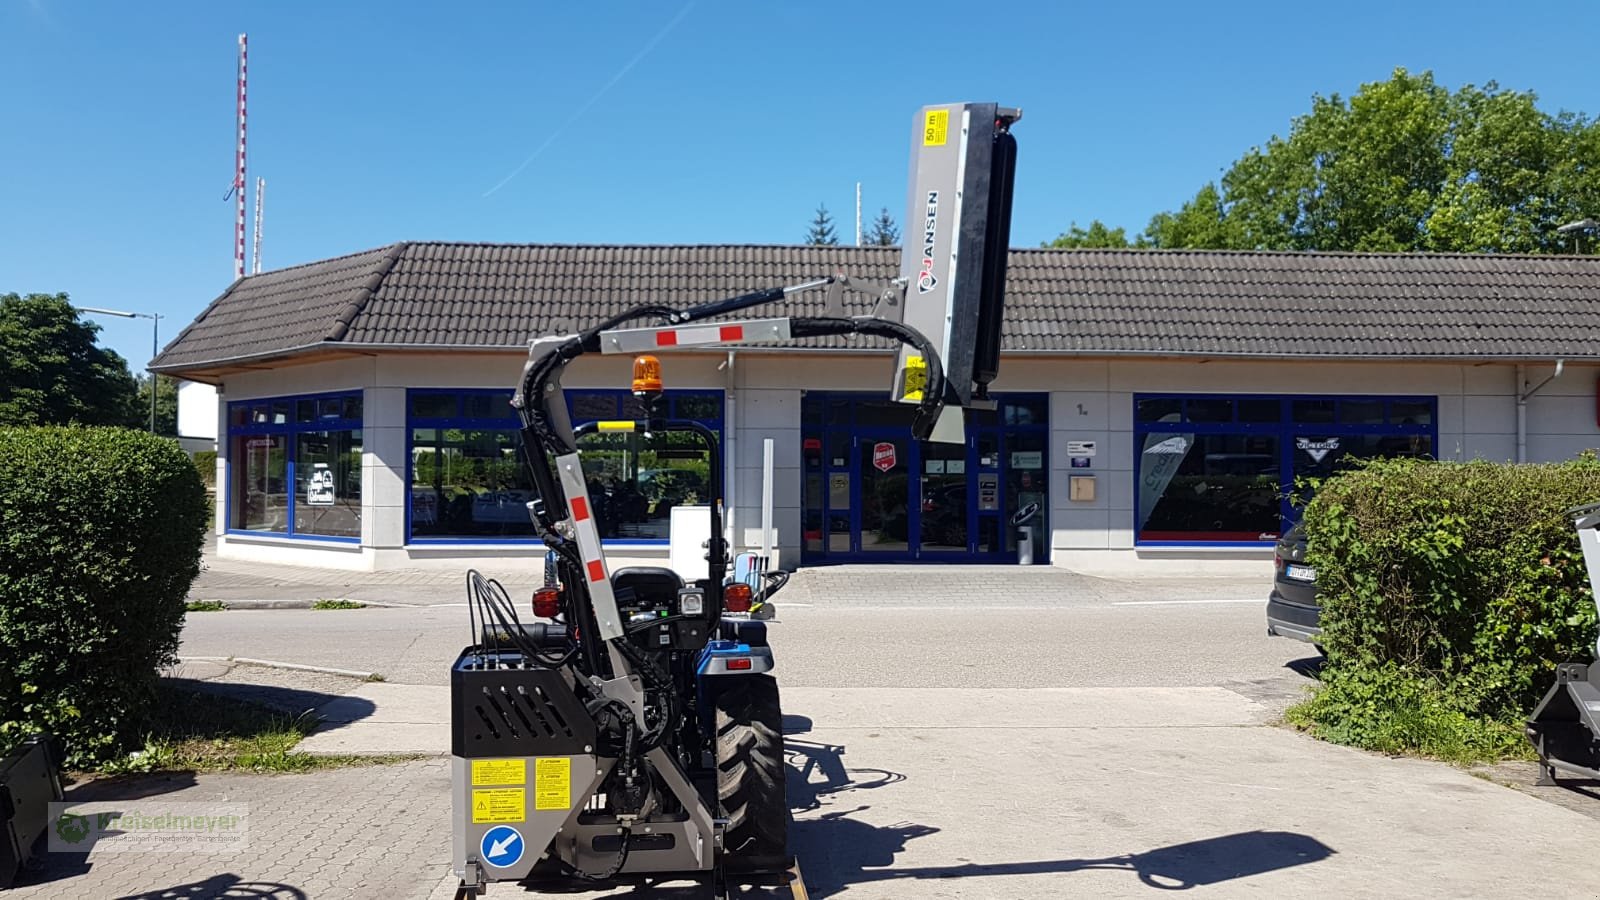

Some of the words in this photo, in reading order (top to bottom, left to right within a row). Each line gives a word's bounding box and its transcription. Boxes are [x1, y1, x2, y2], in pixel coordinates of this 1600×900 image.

[929, 115, 936, 125] m
[926, 128, 935, 141] 50
[923, 192, 938, 269] JANSEN
